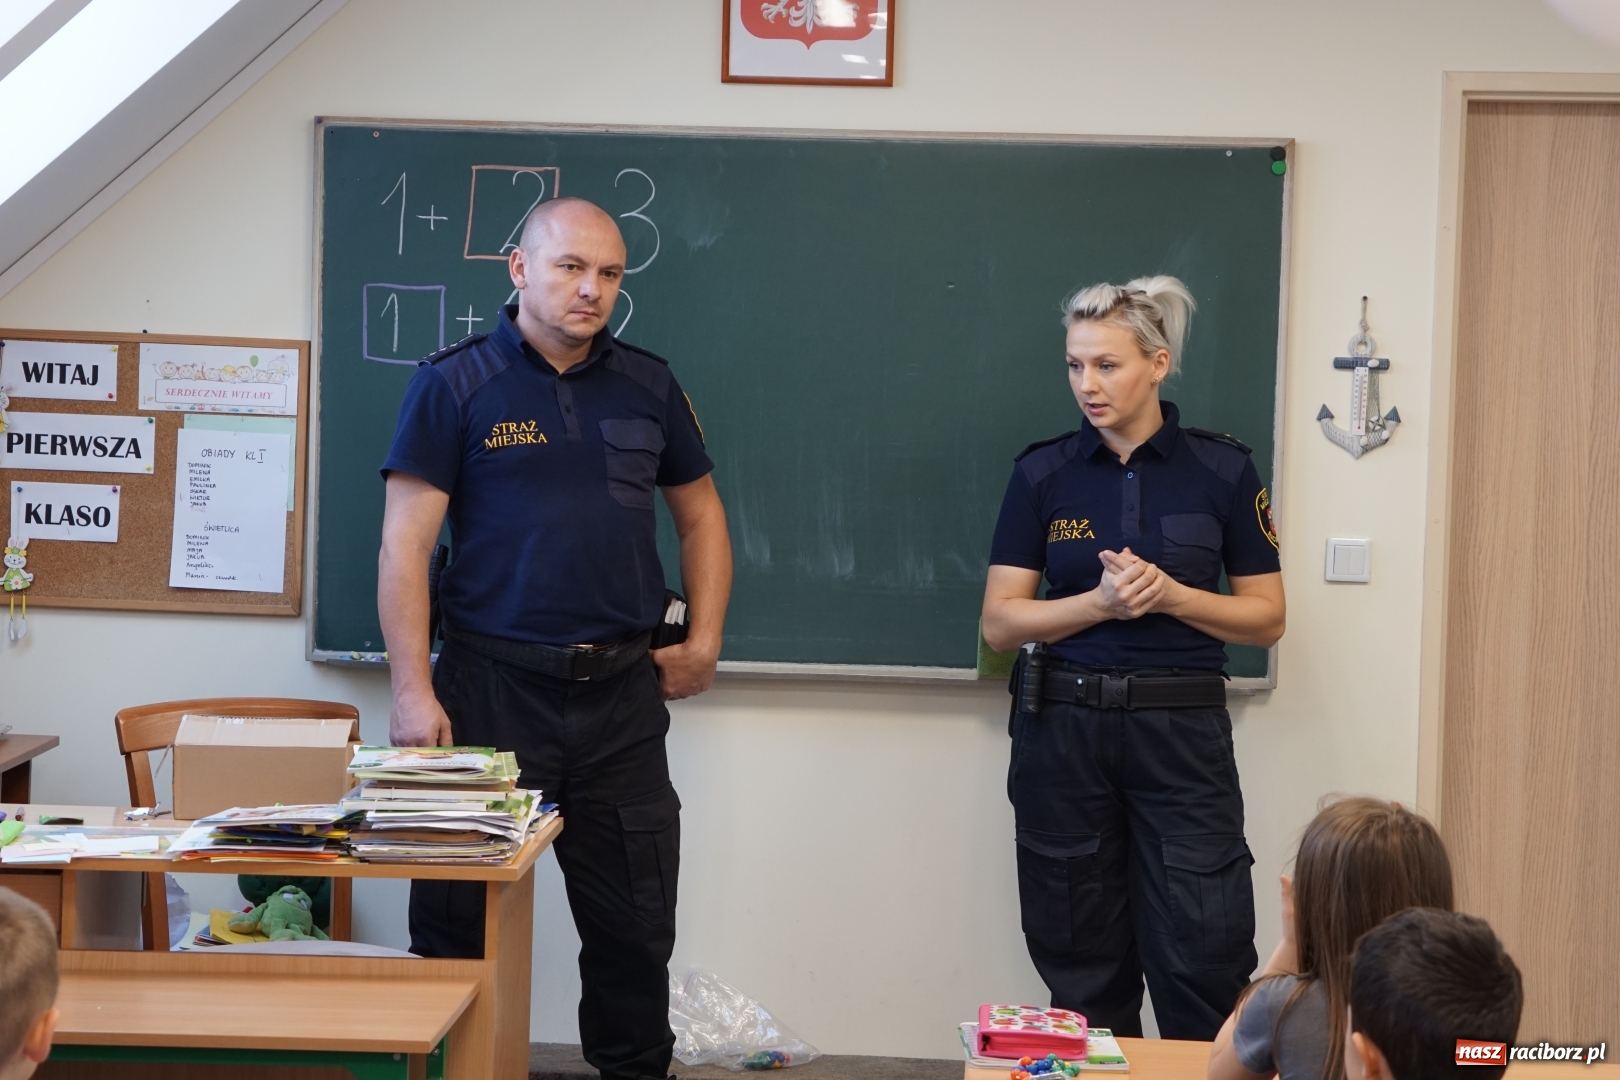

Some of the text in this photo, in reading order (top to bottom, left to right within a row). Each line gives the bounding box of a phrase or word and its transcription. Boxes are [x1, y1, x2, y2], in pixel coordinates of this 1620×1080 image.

[381, 171, 406, 255] 1
[500, 169, 545, 254] 2
[614, 168, 660, 274] 3
[380, 292, 399, 353] 1
[22, 361, 99, 386] WITAJ
[165, 387, 273, 400] SERDECZNIE WITAMY
[492, 419, 539, 436] STRAŻ
[6, 432, 142, 459] PIERWSZA
[484, 432, 548, 450] MIEJSKA
[201, 448, 236, 458] OBIADY
[245, 451, 256, 460] KL
[24, 503, 111, 528] KLASO
[204, 521, 240, 533] ŚWIETLICA
